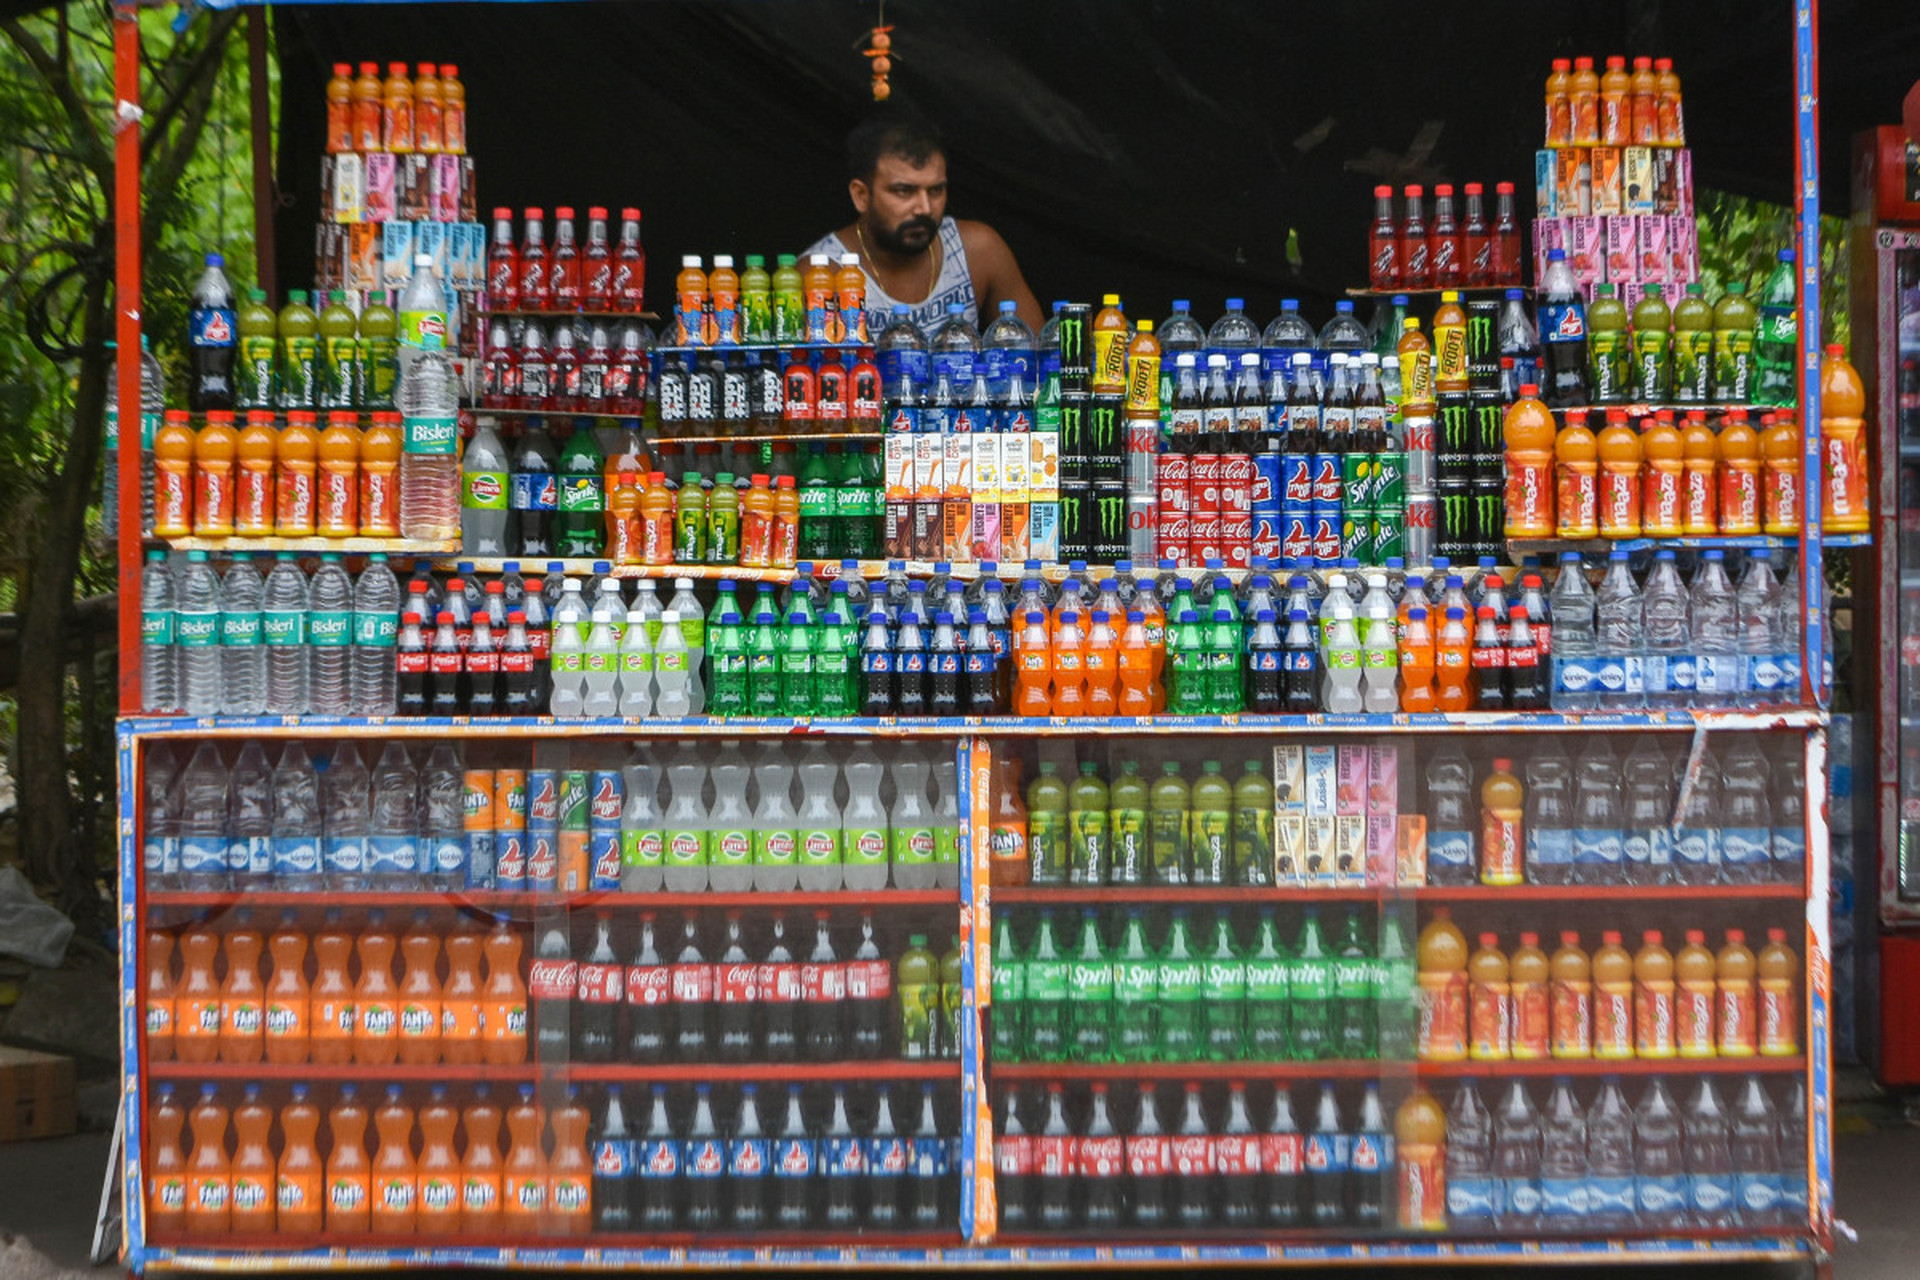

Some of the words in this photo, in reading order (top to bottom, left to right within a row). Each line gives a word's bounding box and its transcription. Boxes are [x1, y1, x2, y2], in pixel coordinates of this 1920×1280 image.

[1107, 334, 1124, 382] FROOTI
[1443, 329, 1463, 376] FROOTI
[788, 376, 804, 400] B
[858, 375, 875, 399] B
[1134, 360, 1150, 406] FROOTI
[1414, 354, 1429, 398] FROOTI
[821, 376, 838, 401] B
[412, 423, 456, 441] Bisleri
[471, 483, 500, 493] Limca
[1352, 476, 1372, 503] Spri
[1373, 465, 1396, 491] prite
[1828, 440, 1850, 515] maaza
[168, 471, 182, 529] maaza
[207, 473, 221, 529] maaza
[249, 473, 263, 529] maaza
[293, 473, 308, 529] maaza
[330, 471, 347, 529] maaza
[369, 473, 382, 529] maaza
[567, 486, 595, 502] Sprite
[837, 489, 871, 505] Sprite
[1525, 467, 1535, 528] maaza
[1580, 476, 1595, 528] maaza
[1612, 473, 1628, 528] maaza
[1660, 473, 1674, 527] maaza
[1689, 473, 1705, 527] maaza
[1742, 473, 1755, 527] maaza
[1779, 473, 1793, 527] maaza
[180, 620, 215, 634] Bisleri
[224, 618, 259, 633] Bisleri
[312, 619, 346, 633] Bisleri
[671, 840, 699, 852] Limca
[720, 840, 748, 851] Limca
[766, 840, 794, 851] Limca
[805, 839, 833, 851] Limca
[857, 839, 884, 851] Limca
[530, 962, 577, 985] Coca-Cola
[629, 968, 668, 986] Coca-Cola
[1073, 965, 1112, 986] Sprit
[1159, 965, 1199, 987] Sprit
[267, 1010, 297, 1024] FANTA
[364, 1011, 395, 1025] FANTA
[402, 1011, 432, 1024] FANTA
[332, 1185, 365, 1201] FANTA
[423, 1185, 455, 1201] FANTA
